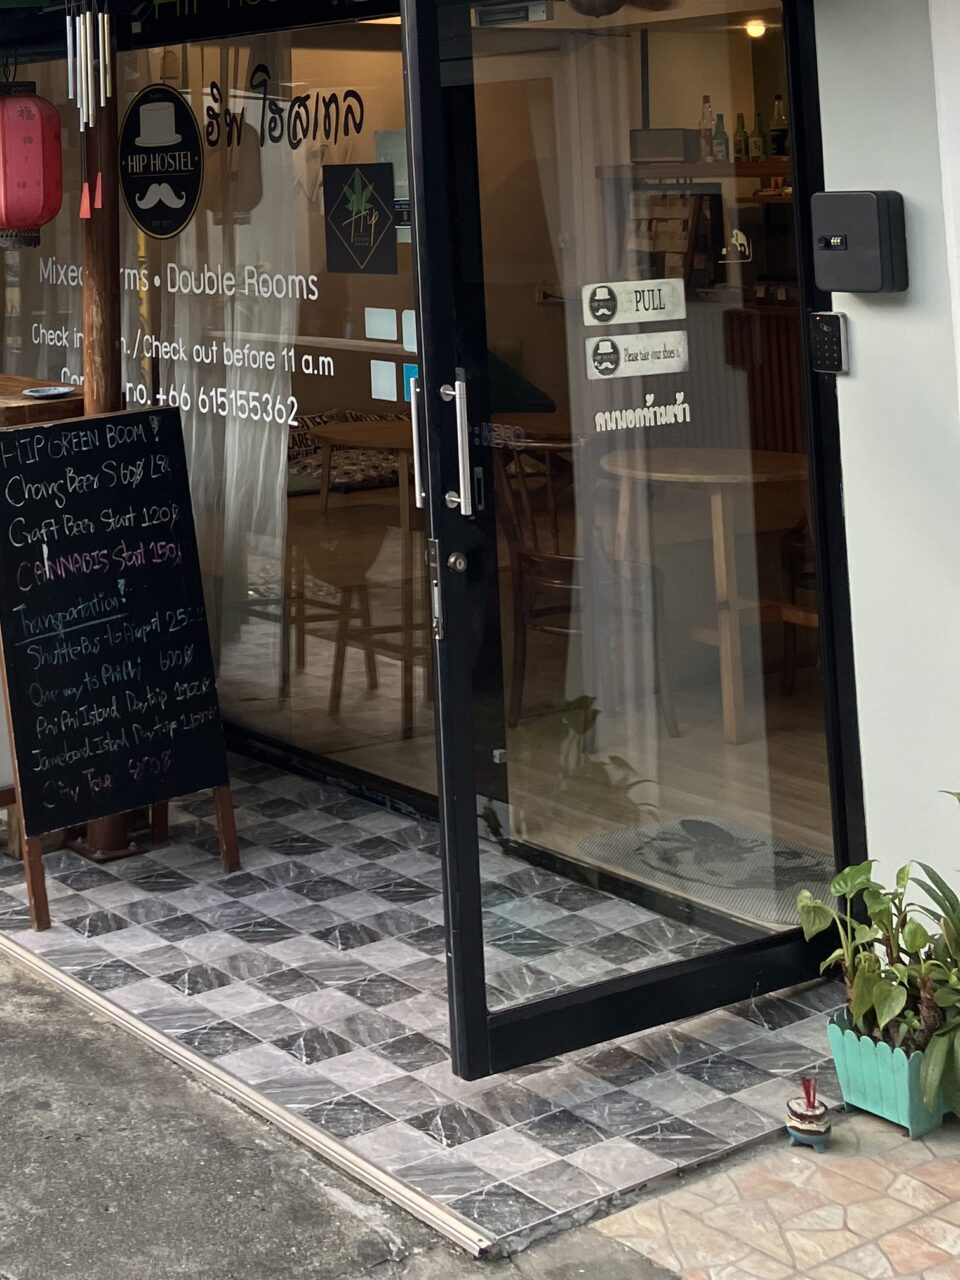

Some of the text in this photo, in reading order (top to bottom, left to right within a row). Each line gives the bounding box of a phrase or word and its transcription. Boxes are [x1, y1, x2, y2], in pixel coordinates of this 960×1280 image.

[128, 151, 195, 174] HIP HOSTEL
[167, 263, 236, 296] Double
[244, 265, 319, 300] Rooms
[634, 288, 666, 312] PULL
[32, 323, 69, 348] Check
[193, 340, 218, 364] out
[223, 342, 276, 371] before
[281, 347, 295, 372] 11
[302, 353, 335, 377] a.m
[126, 382, 151, 405] no.
[155, 384, 190, 411] +66
[198, 386, 299, 427] 615155362
[1, 434, 45, 468] HIP
[48, 429, 100, 459] GREEN
[65, 466, 100, 494] Beer
[8, 516, 61, 548] Craft
[62, 513, 96, 538] Beer
[100, 506, 137, 532] Start
[16, 547, 111, 592] CANNABIS
[112, 539, 145, 572] Start
